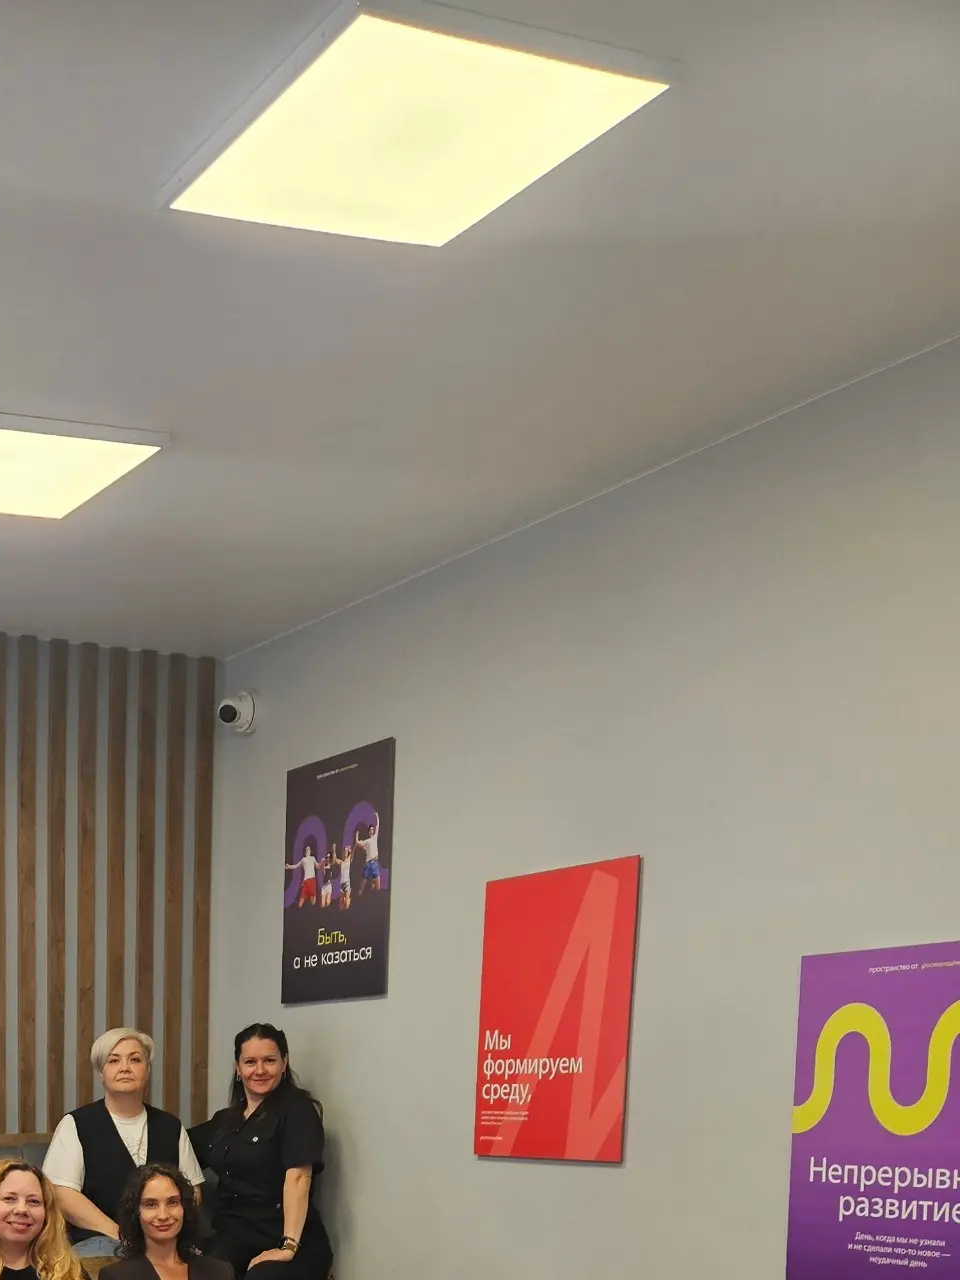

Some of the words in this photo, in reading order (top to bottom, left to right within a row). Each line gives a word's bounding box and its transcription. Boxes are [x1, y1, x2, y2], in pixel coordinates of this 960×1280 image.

[317, 928, 347, 946] Быть,
[293, 956, 300, 969] а
[304, 954, 318, 968] не
[321, 946, 372, 965] казаться
[484, 1029, 511, 1050] Мы
[483, 1053, 583, 1080] формируем
[482, 1083, 531, 1105] среду,
[838, 1195, 960, 1224] развитие
[855, 1231, 874, 1241] День,
[875, 1235, 895, 1243] когда
[896, 1236, 908, 1244] мы
[919, 1239, 946, 1247] узнали
[853, 1243, 862, 1251] не
[863, 1245, 893, 1253] сделали
[893, 1248, 916, 1256] что-то
[917, 1250, 941, 1258] новое
[869, 1256, 909, 1266] неудачный
[909, 1260, 928, 1268] день
